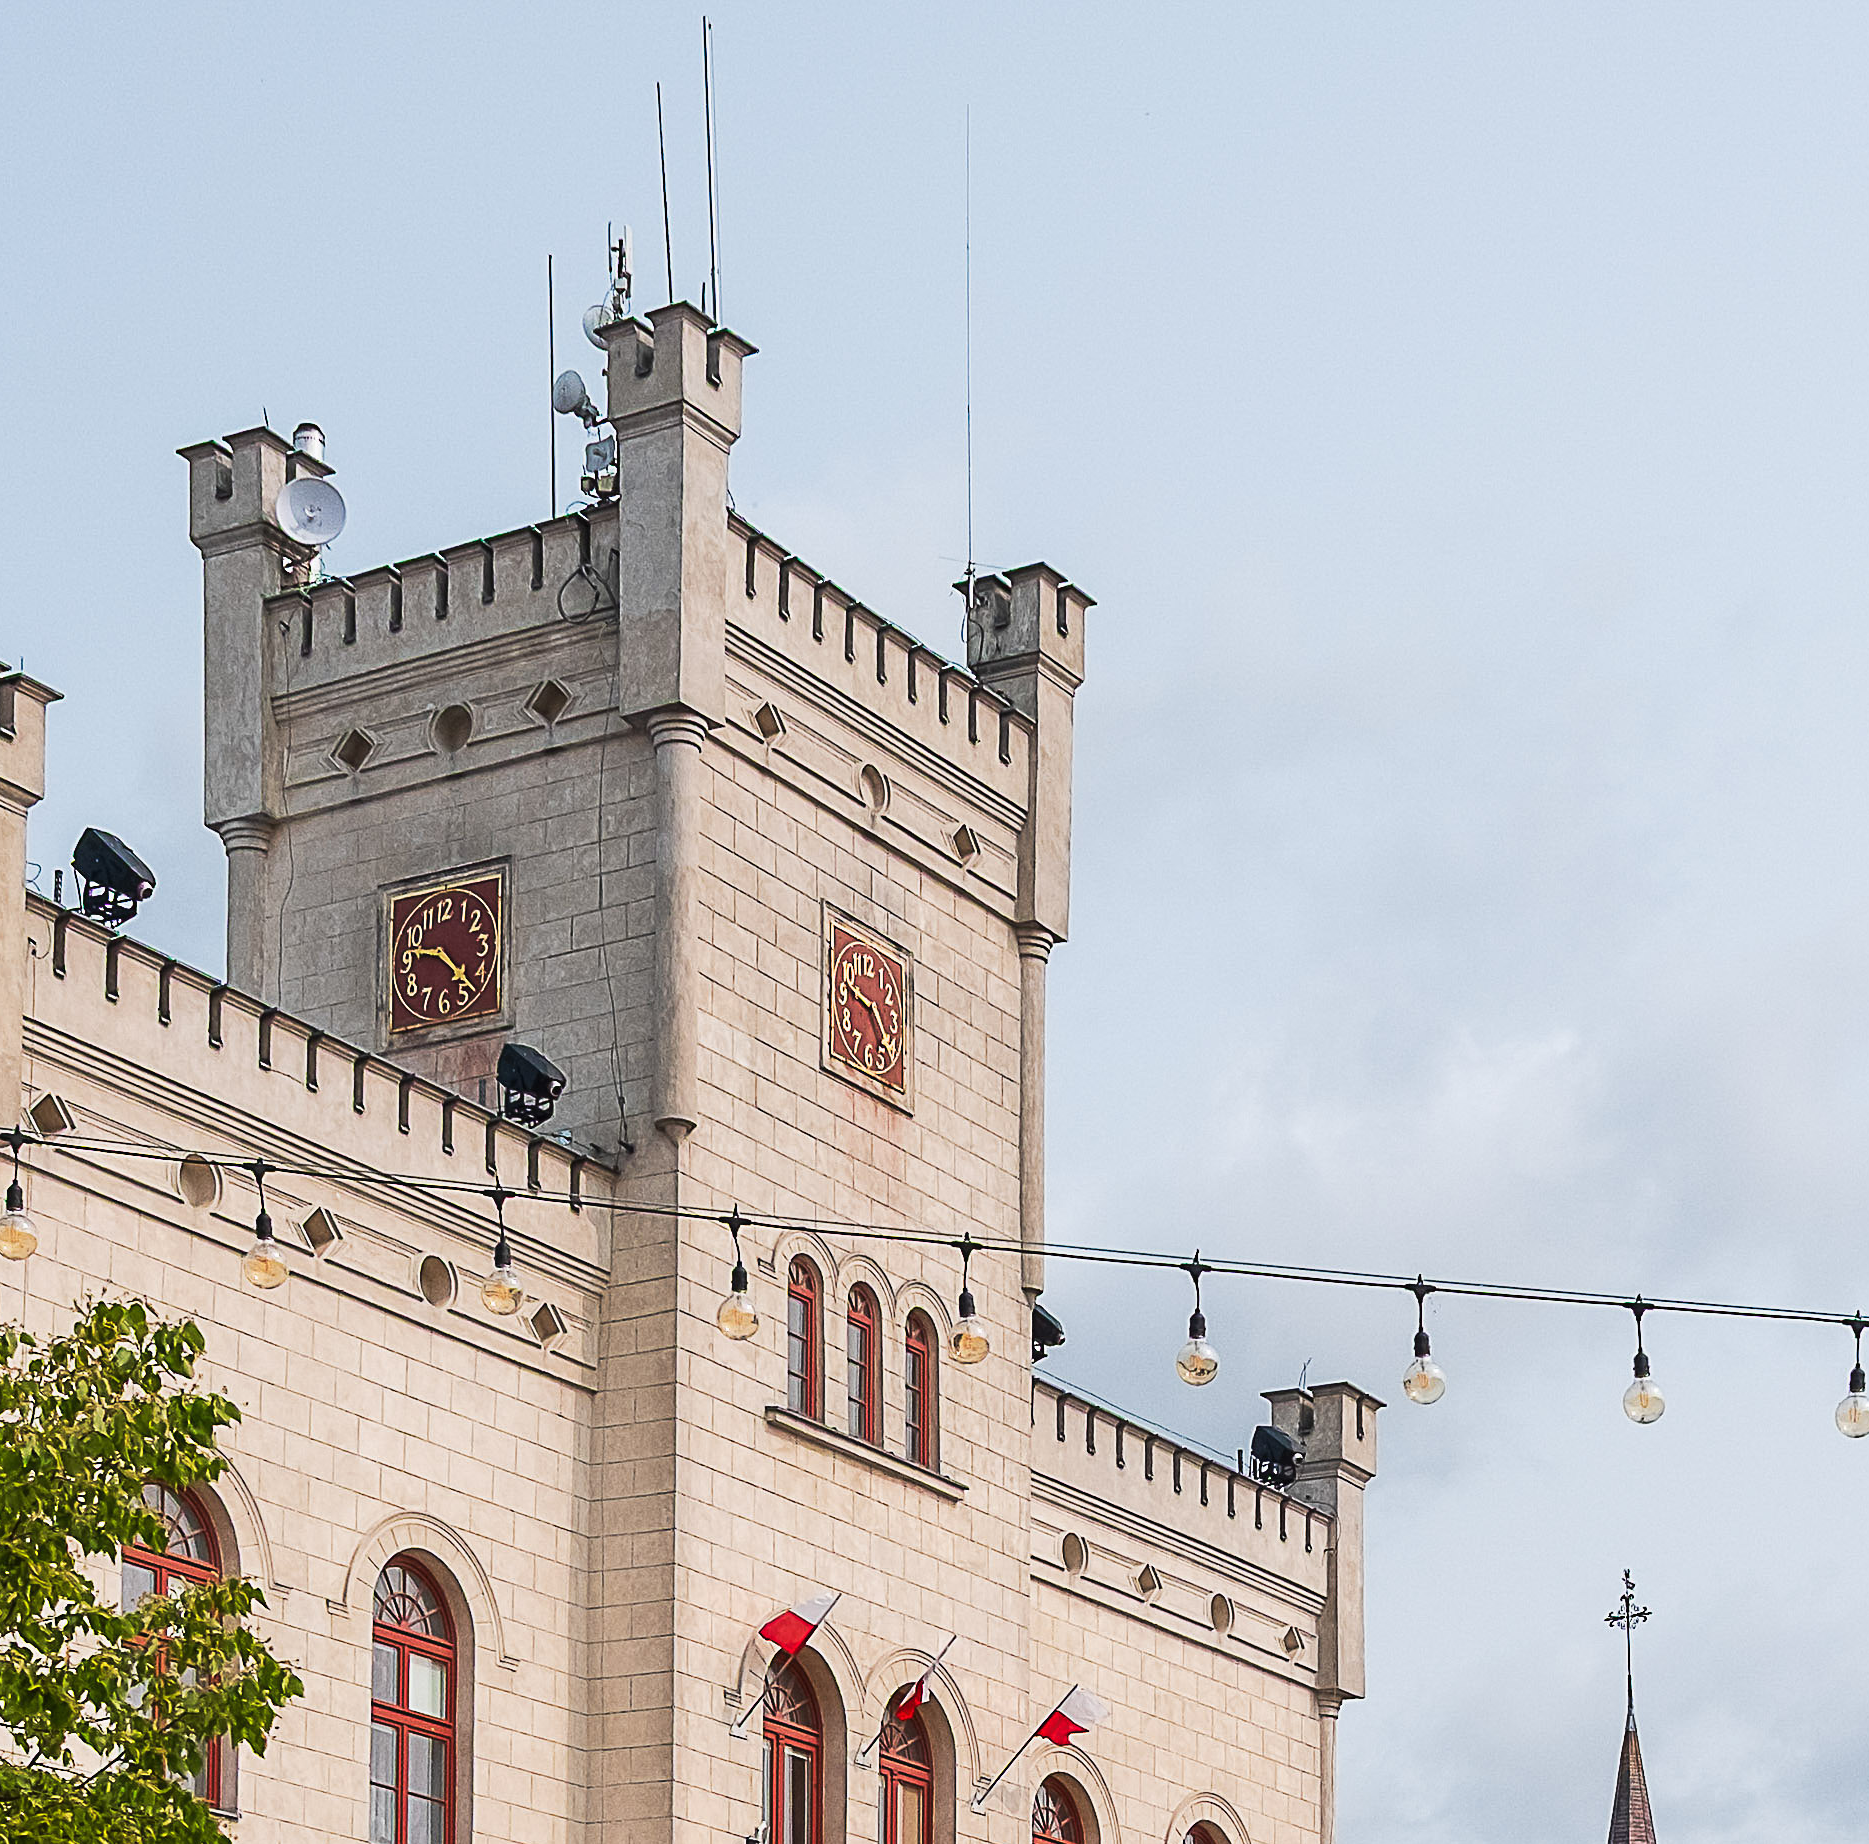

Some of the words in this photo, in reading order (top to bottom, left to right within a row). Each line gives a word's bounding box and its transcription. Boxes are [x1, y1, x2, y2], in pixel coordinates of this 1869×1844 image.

[423, 907, 433, 930] 11
[437, 899, 453, 923] 12
[461, 899, 467, 922] 1
[469, 910, 481, 933] 2
[407, 924, 422, 947] 10
[477, 934, 488, 957] 3
[400, 950, 412, 974] 9
[475, 960, 485, 983] 4
[843, 962, 855, 984] 10
[853, 952, 862, 976] 11
[863, 954, 875, 978] 12
[407, 973, 417, 997] 8
[879, 968, 884, 989] 1
[421, 987, 432, 1011] 7
[439, 989, 450, 1013] 6
[458, 983, 469, 1006] 5
[839, 982, 848, 1005] 9
[885, 984, 893, 1006] 2
[842, 1009, 851, 1032] 8
[889, 1010, 898, 1034] 3
[852, 1031, 862, 1054] 7
[865, 1044, 873, 1067] 6
[876, 1045, 885, 1069] 5
